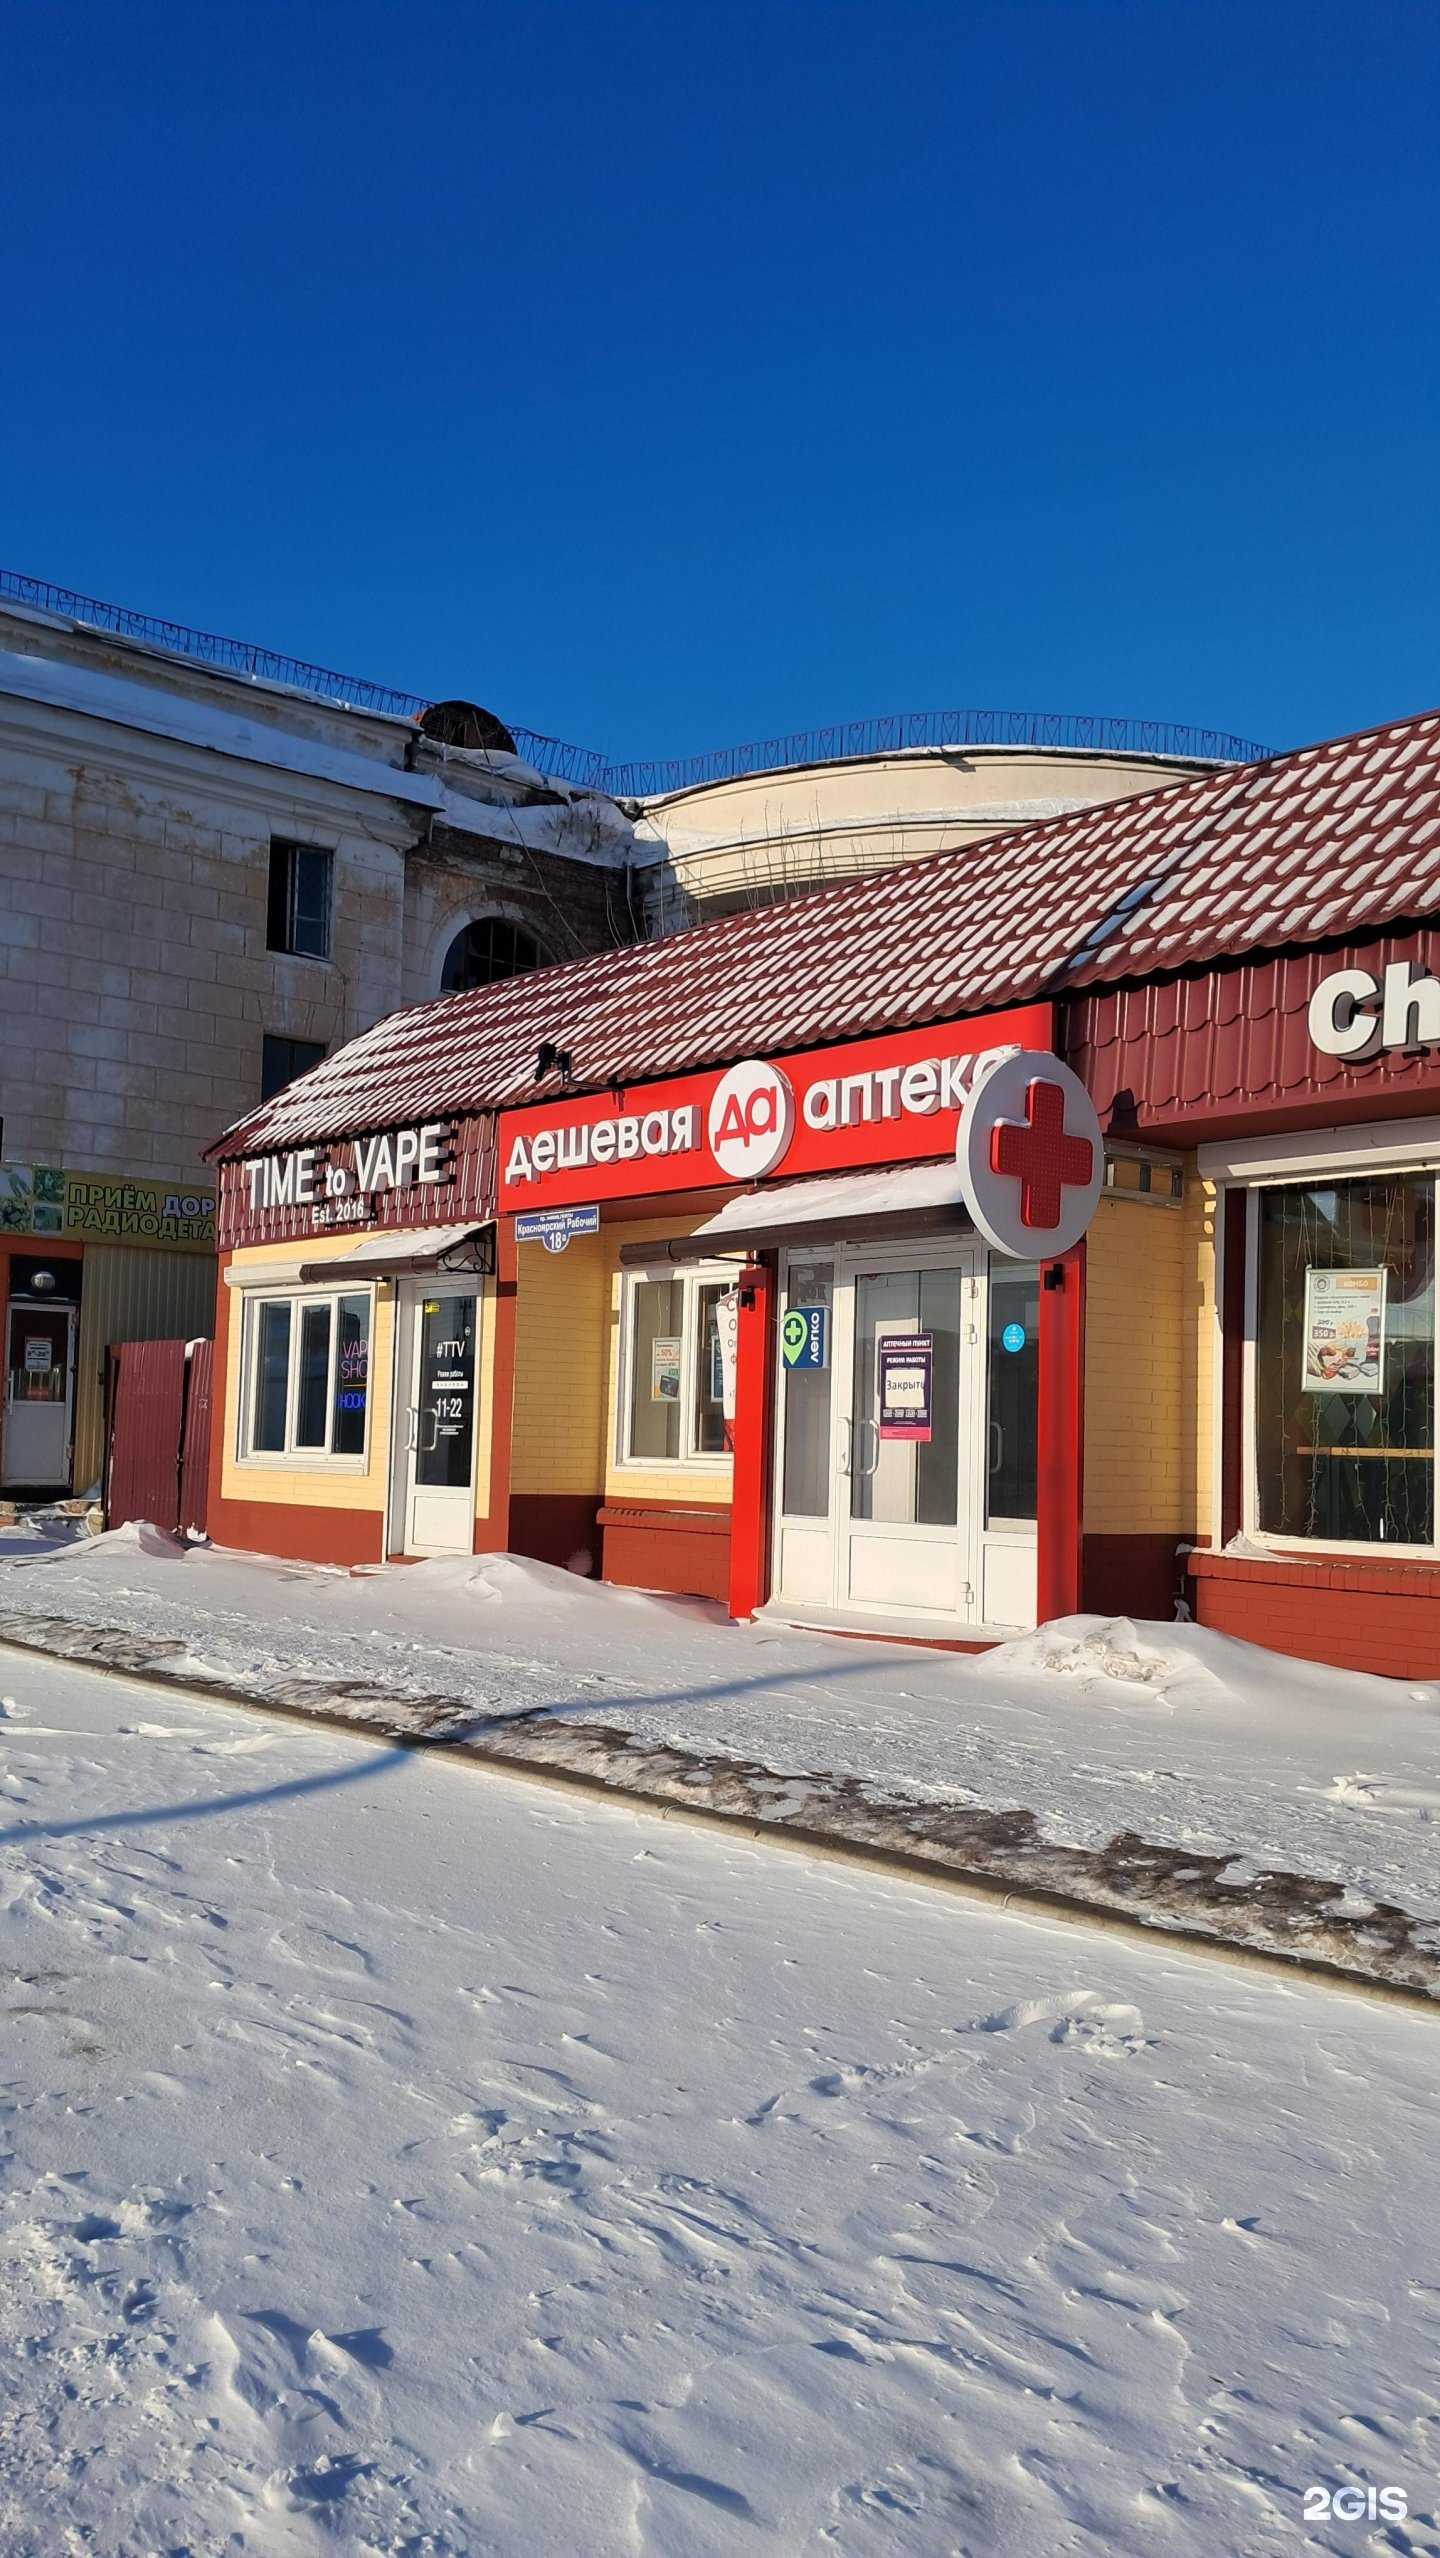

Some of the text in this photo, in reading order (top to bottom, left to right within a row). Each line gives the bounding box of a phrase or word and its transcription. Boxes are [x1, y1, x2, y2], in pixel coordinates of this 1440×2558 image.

[245, 1124, 442, 1210] TIME to VAPE
[68, 1182, 157, 1213] ПРИЁМ
[312, 1199, 364, 1224] Est. 2016
[517, 1219, 566, 1237] Красноярский
[566, 1214, 597, 1229] Рабочий
[436, 1340, 465, 1358] #TTV
[436, 1397, 463, 1418] 11-22
